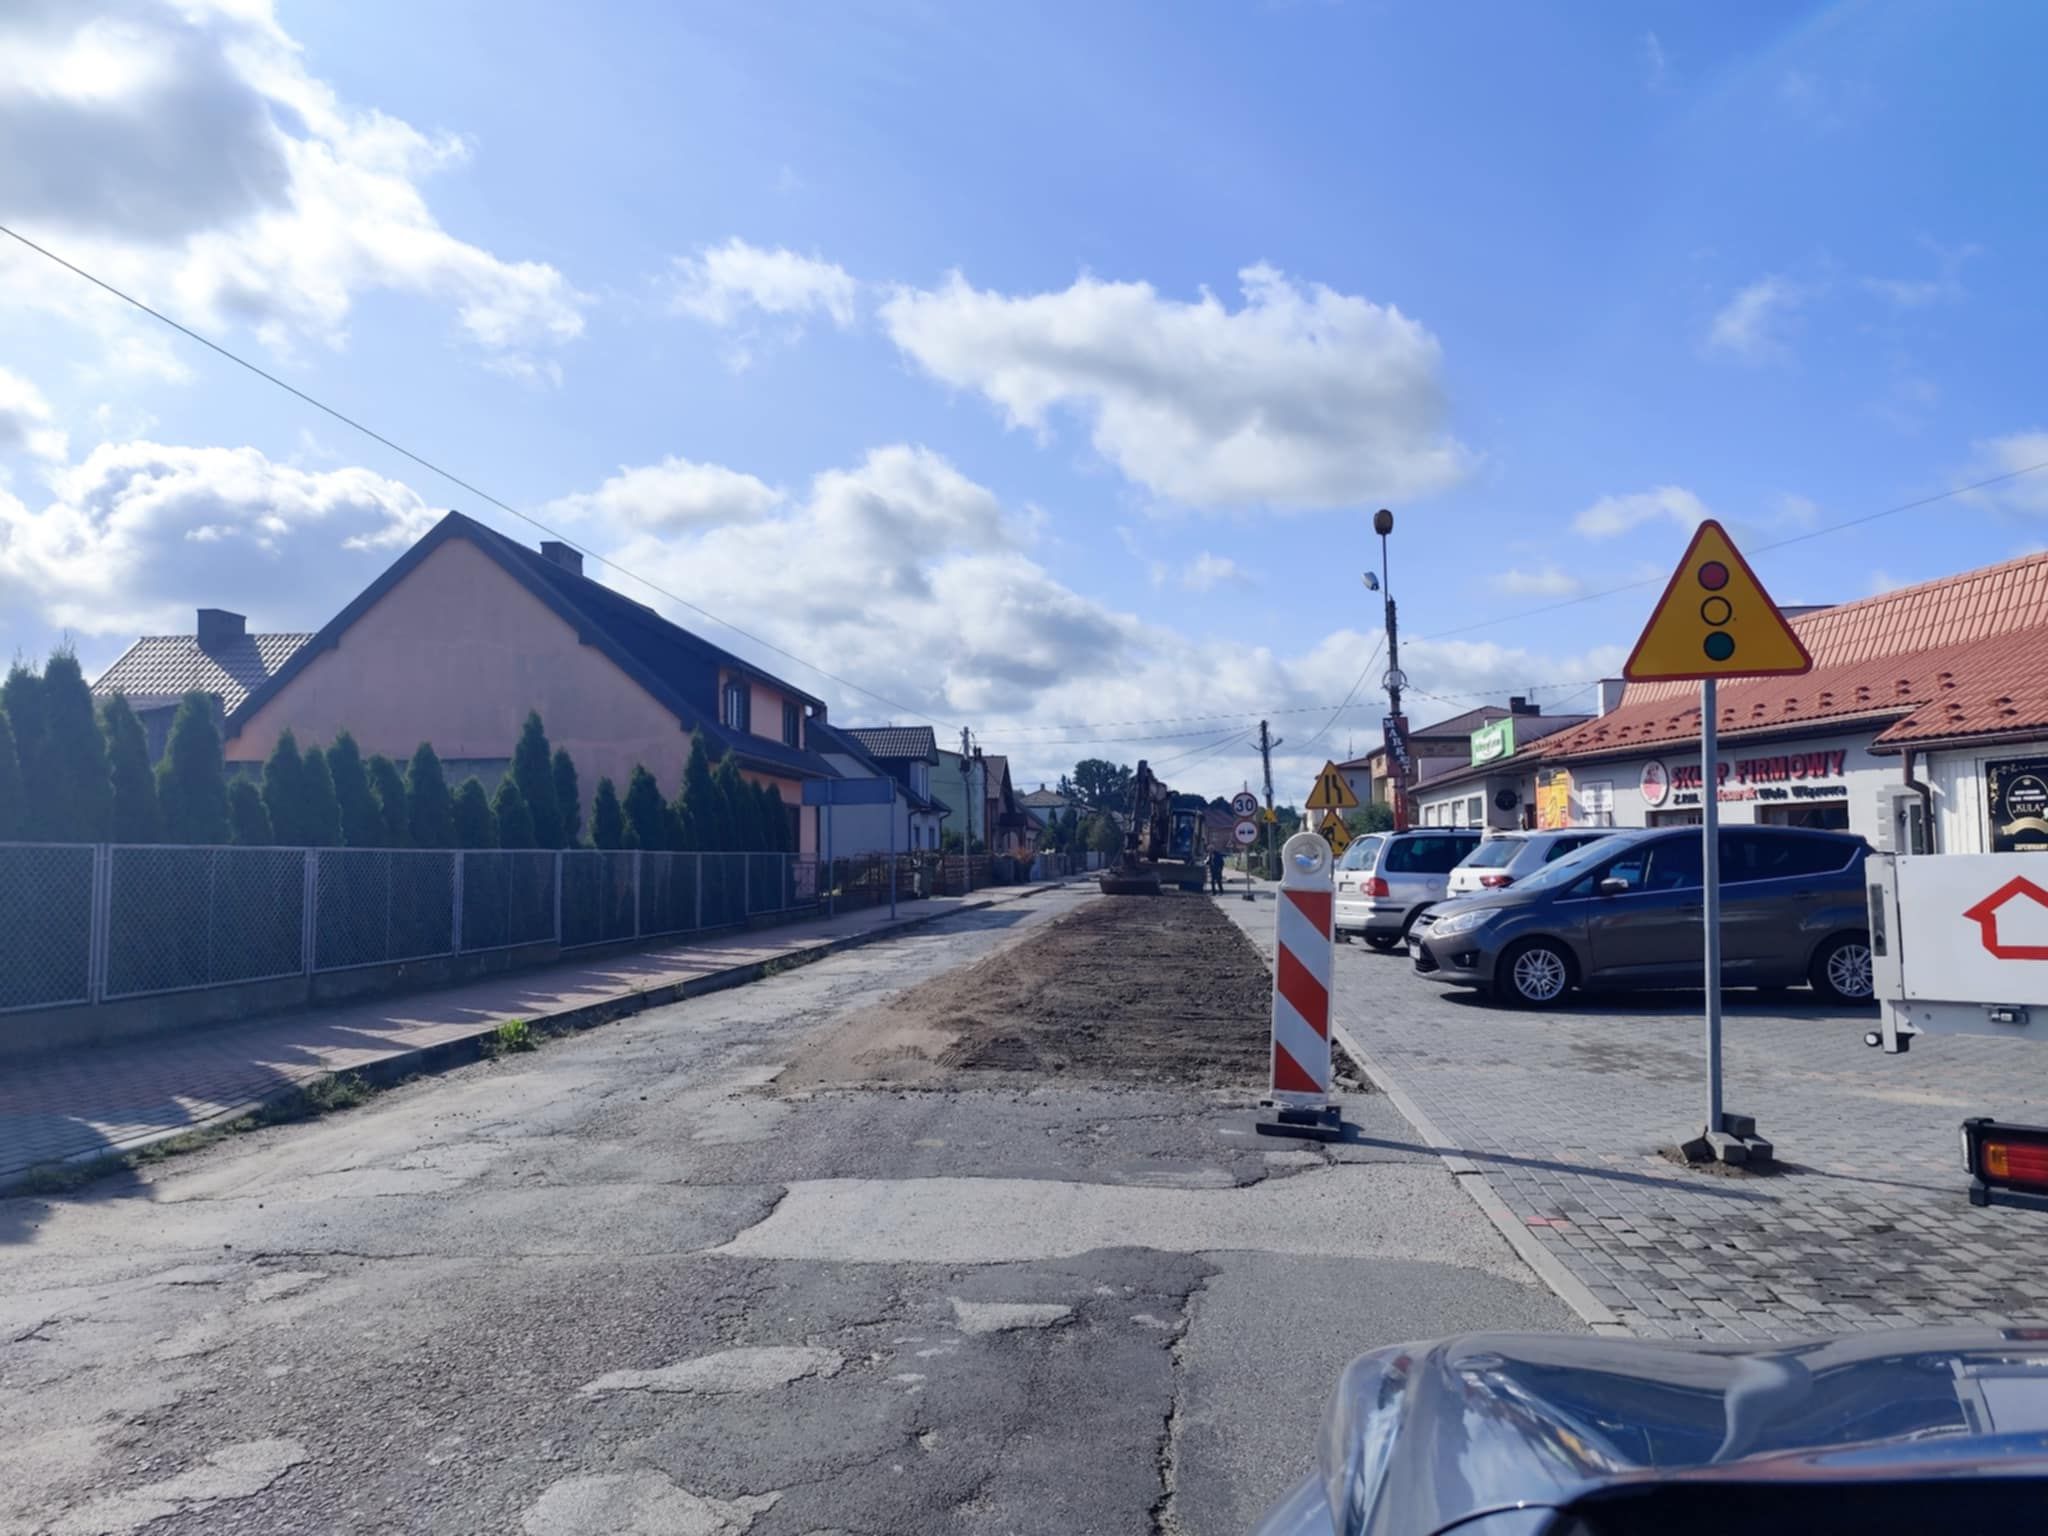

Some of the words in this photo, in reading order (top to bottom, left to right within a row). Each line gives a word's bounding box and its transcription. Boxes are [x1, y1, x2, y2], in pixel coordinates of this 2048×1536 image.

[1383, 719, 1411, 774] MARKET
[1671, 762, 1730, 791] SKLP
[1735, 750, 1847, 784] FIRMOWY
[1236, 799, 1254, 812] 30
